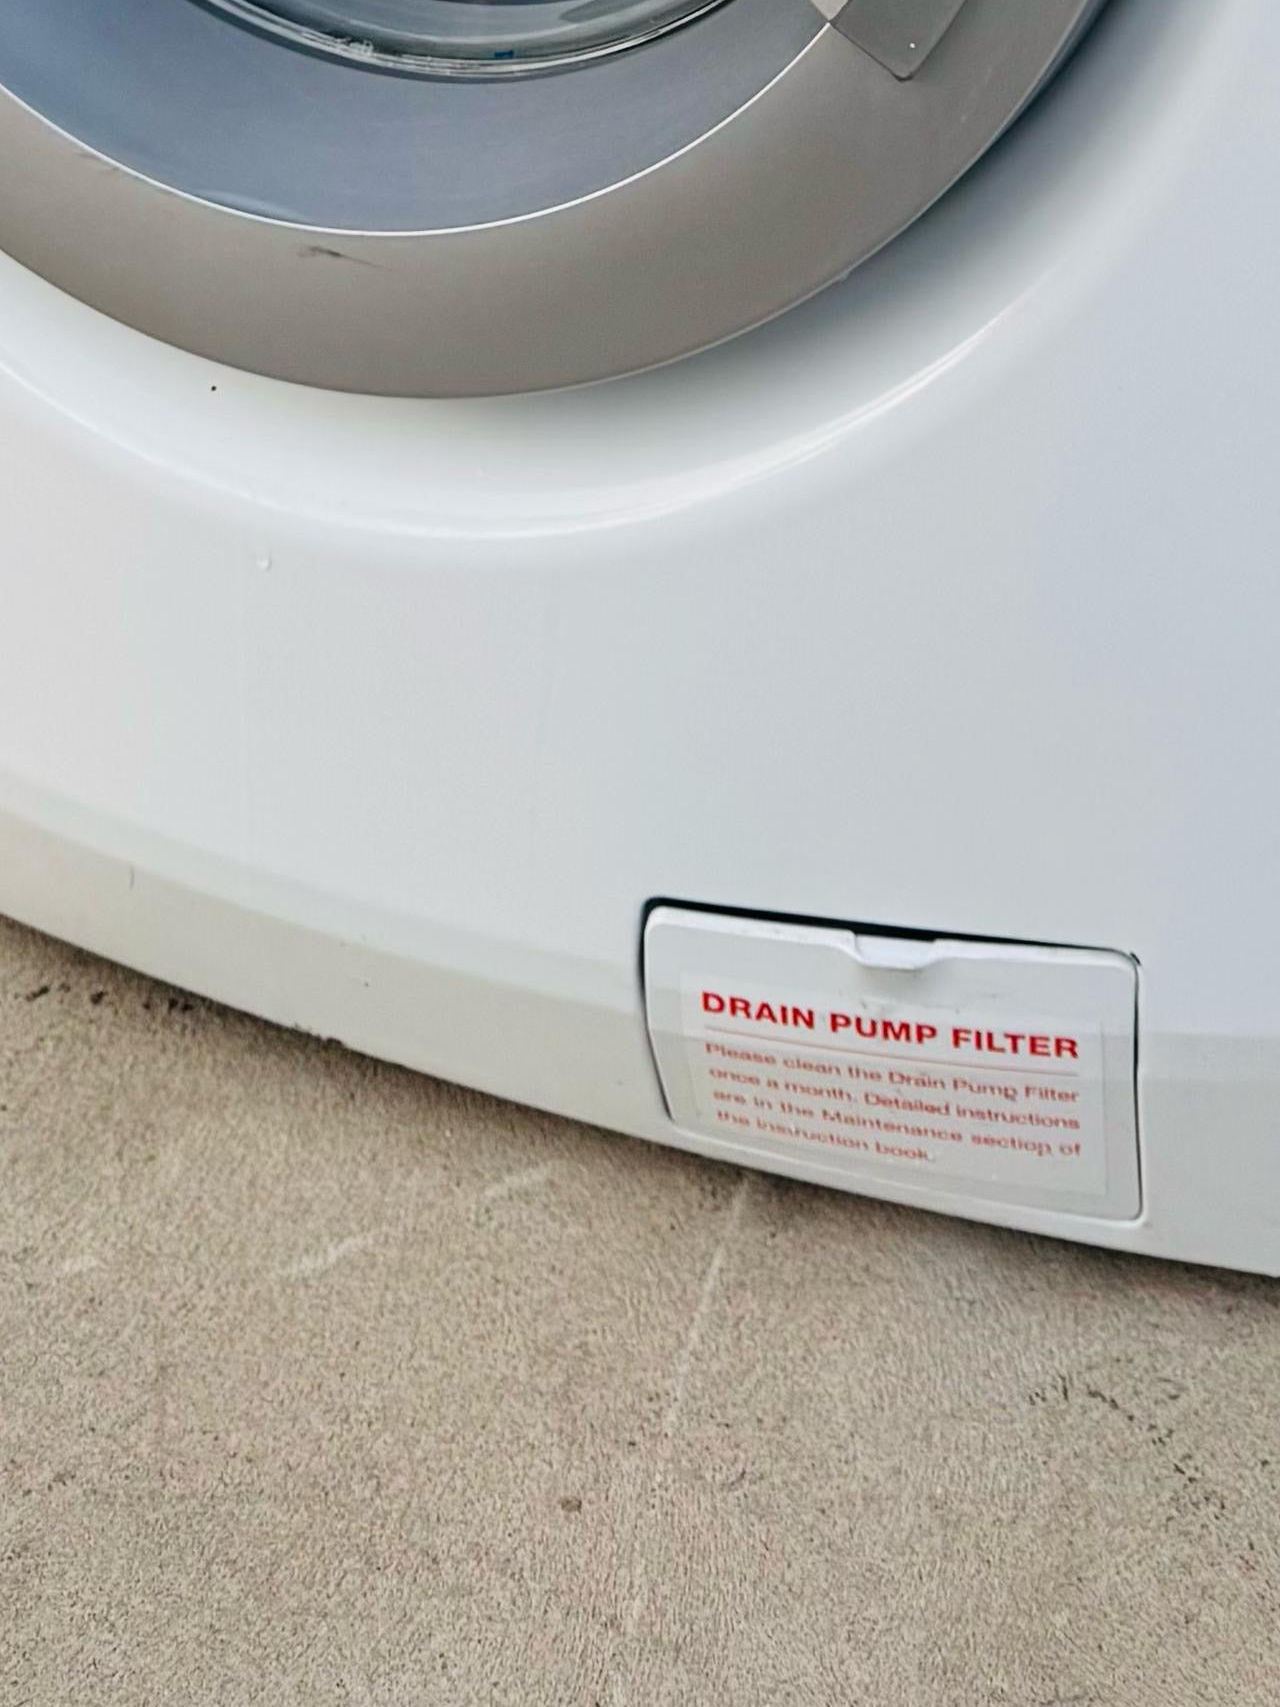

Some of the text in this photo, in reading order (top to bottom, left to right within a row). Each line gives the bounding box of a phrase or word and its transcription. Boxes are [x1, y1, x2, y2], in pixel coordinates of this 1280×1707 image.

[702, 992, 1078, 1059] DRAIN PUMP FILTER
[705, 1042, 1079, 1102] Please clean the Drain Pump Filter
[709, 1068, 760, 1085] once
[864, 1092, 949, 1116] Detailed
[822, 1109, 962, 1142] Maintenance
[1059, 1143, 1080, 1156] of
